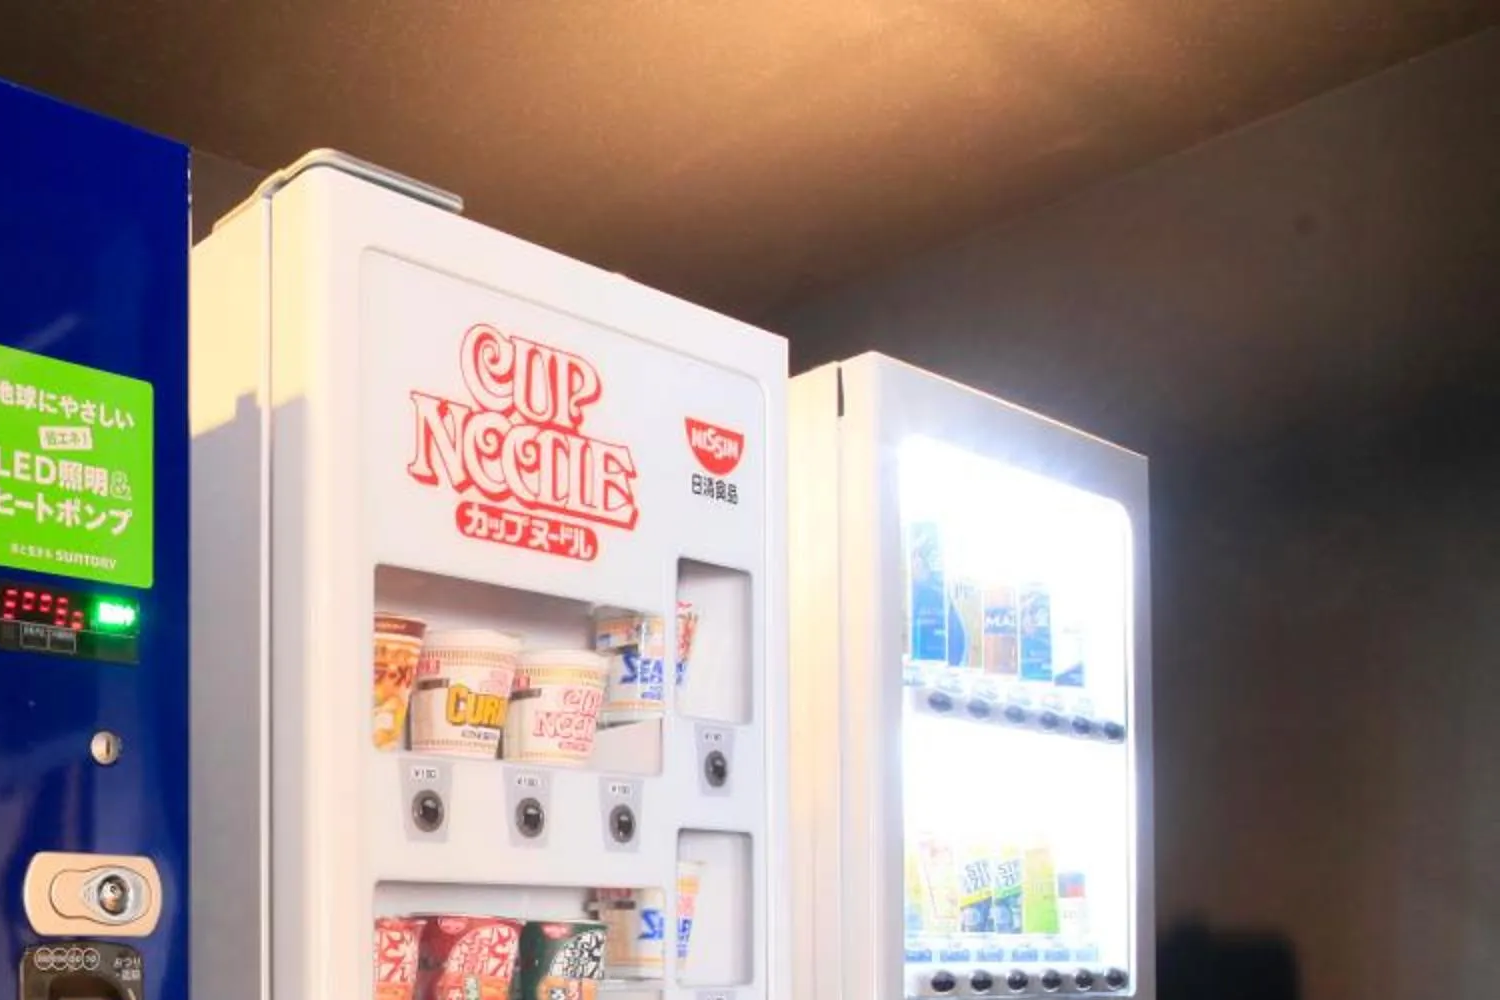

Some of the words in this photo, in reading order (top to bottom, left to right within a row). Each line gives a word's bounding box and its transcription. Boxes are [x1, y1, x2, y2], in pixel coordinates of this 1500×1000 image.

[459, 323, 601, 434] CUP
[407, 390, 639, 531] NOODLE
[692, 427, 740, 460] NISSIN
[463, 505, 594, 558] カップヌードル
